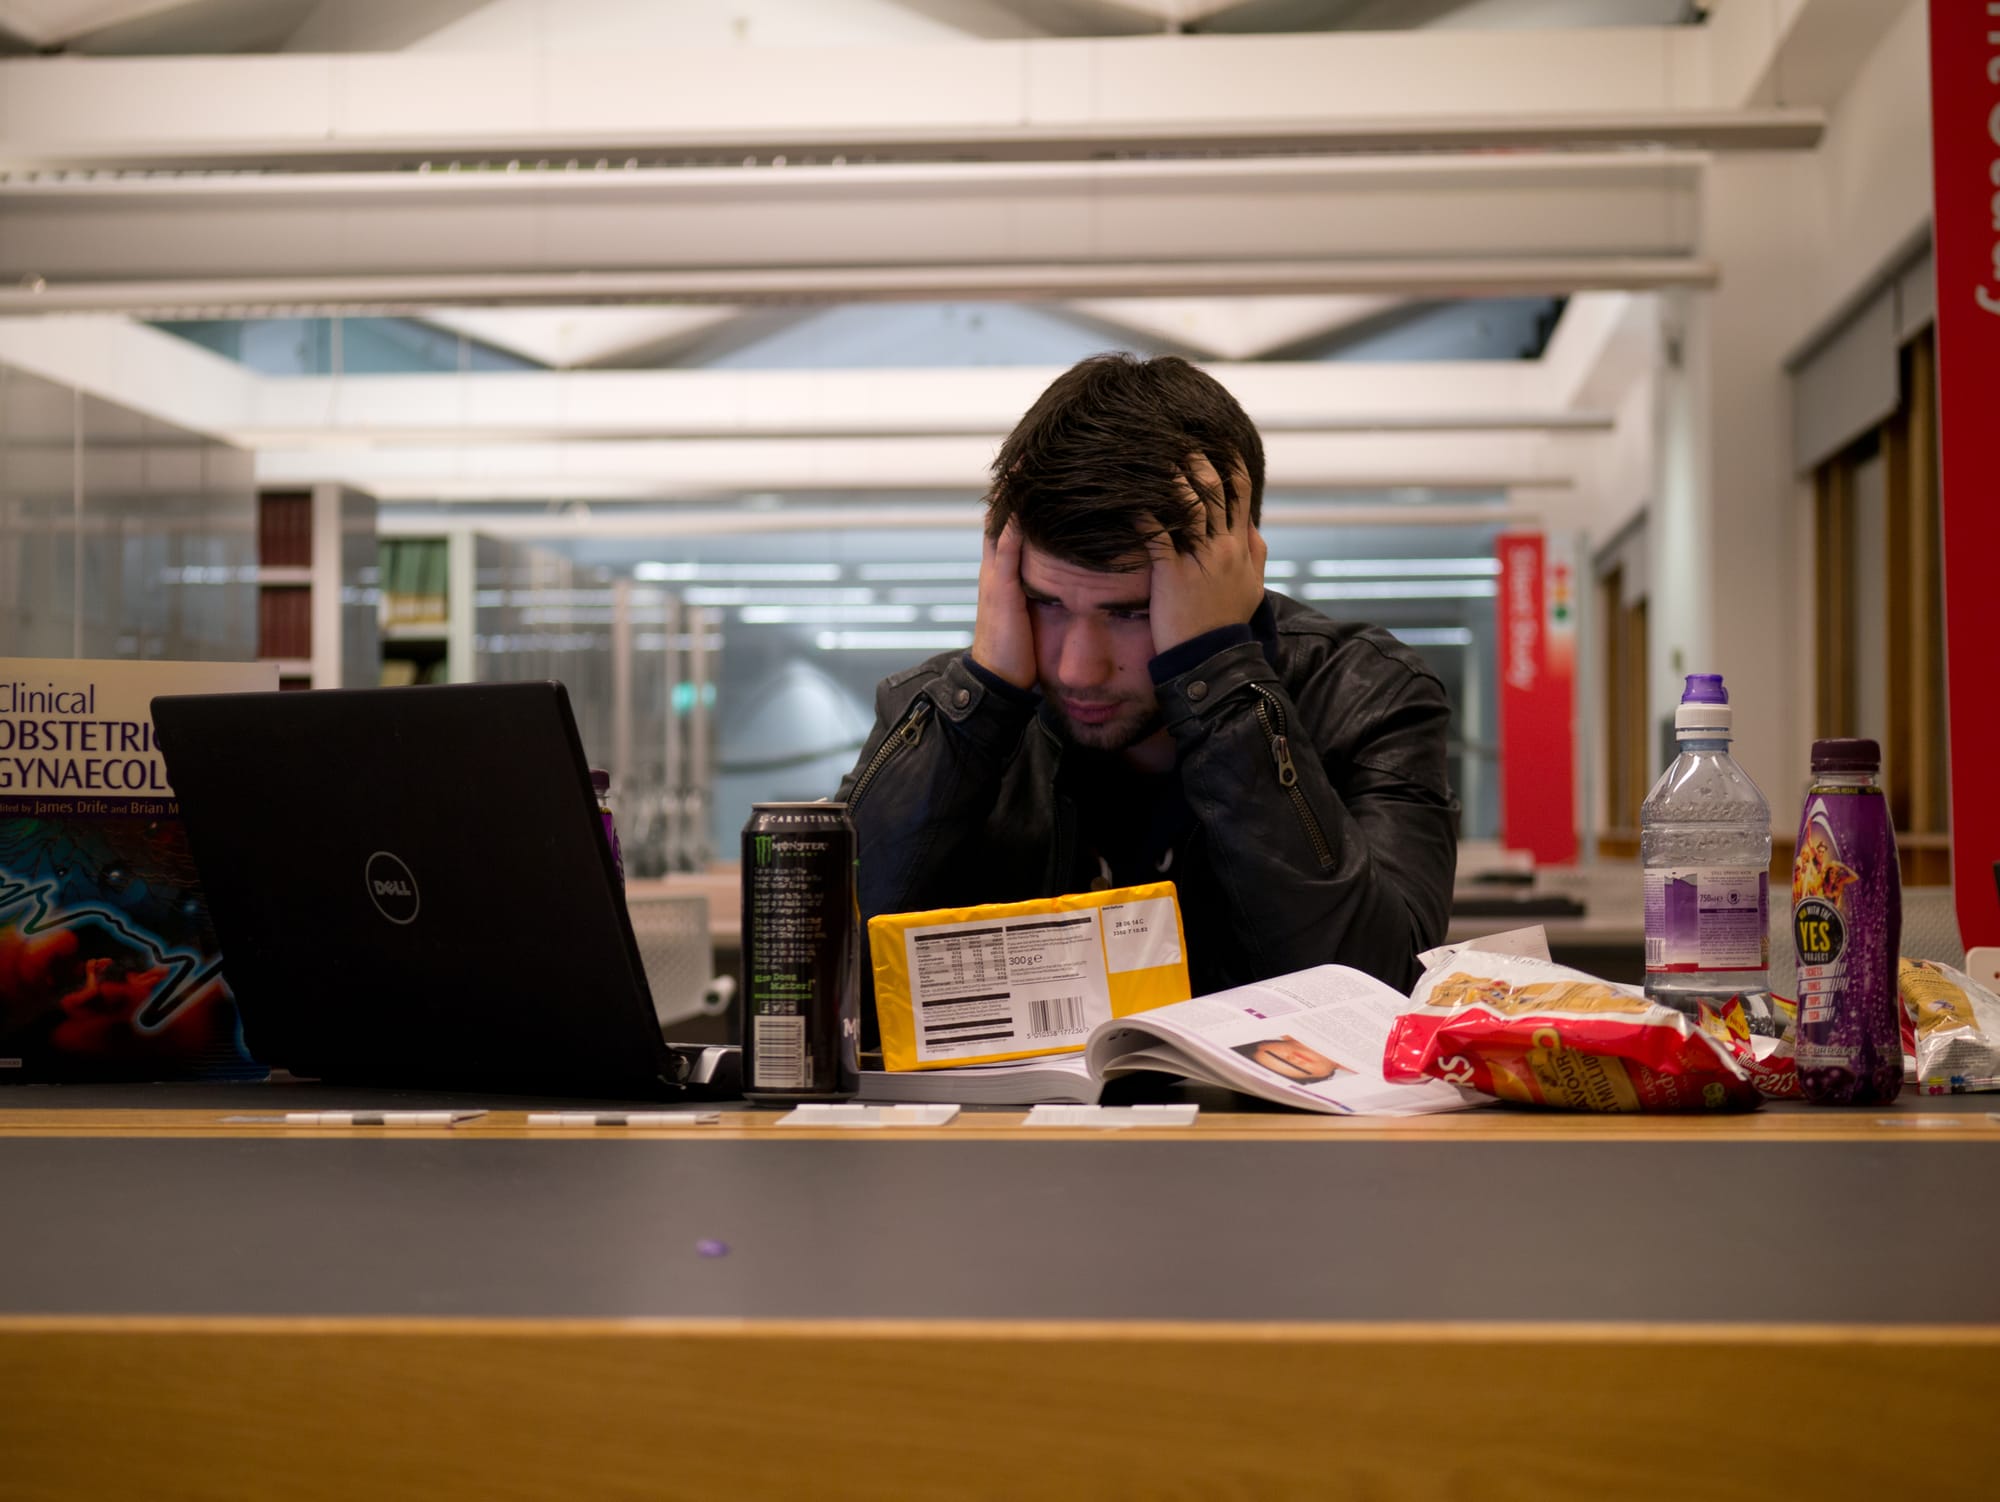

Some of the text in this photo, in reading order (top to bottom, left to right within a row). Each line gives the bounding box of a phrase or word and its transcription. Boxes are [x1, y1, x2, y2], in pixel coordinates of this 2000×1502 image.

[0, 758, 172, 790] GYNAECOL
[34, 800, 73, 815] James
[77, 800, 107, 815] Drife
[111, 804, 127, 814] and
[130, 801, 163, 815] Brian
[771, 840, 826, 852] MONSTER
[373, 879, 412, 897] DELL
[1800, 920, 1831, 952] YES
[1804, 952, 1829, 961] PROJECT
